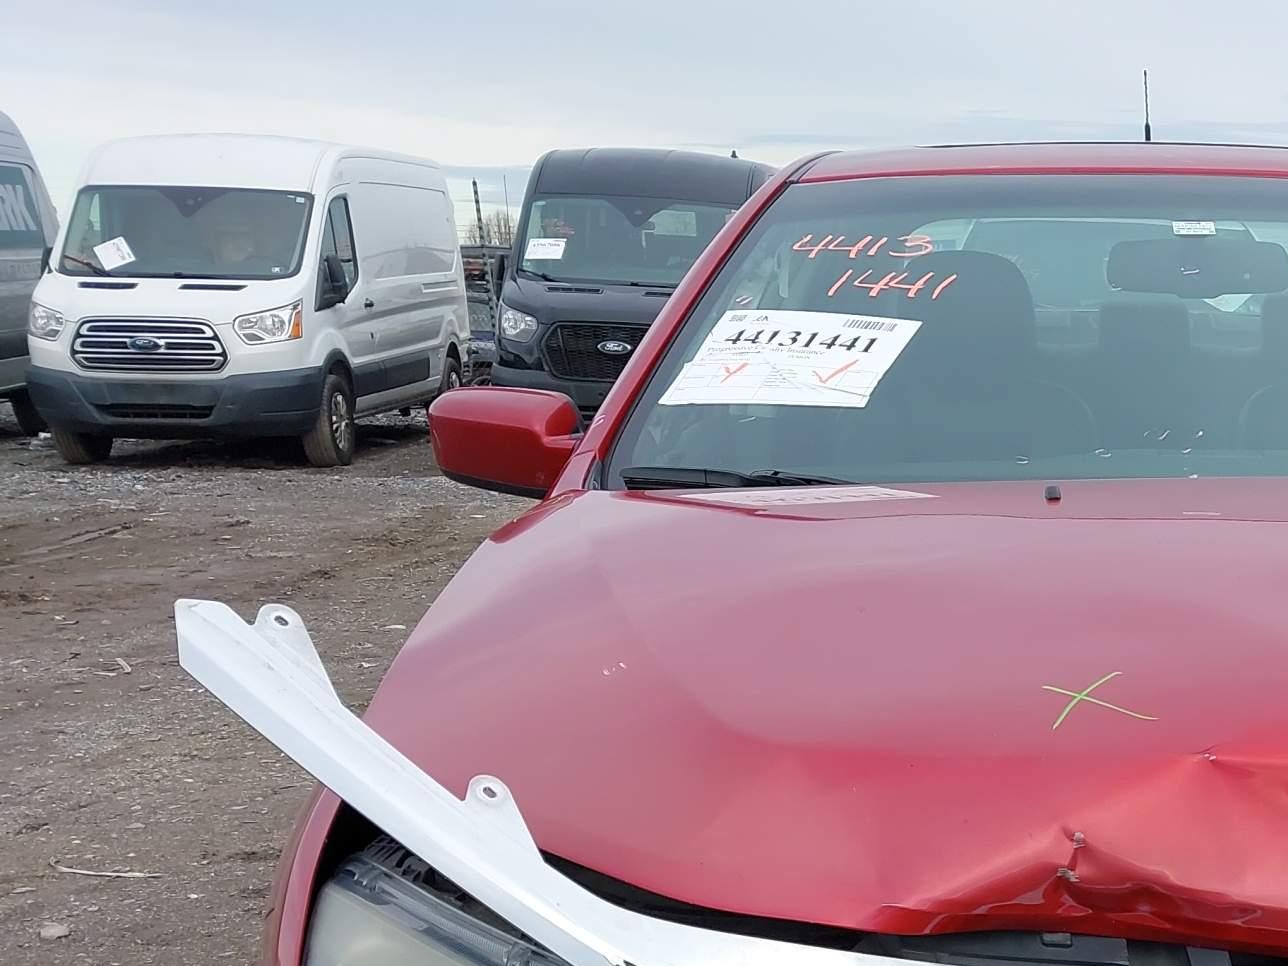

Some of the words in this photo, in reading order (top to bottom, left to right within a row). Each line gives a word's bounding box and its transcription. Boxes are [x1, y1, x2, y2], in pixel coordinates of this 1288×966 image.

[792, 234, 934, 259] 4413
[827, 269, 958, 300] 1441
[724, 328, 878, 353] 44131441
